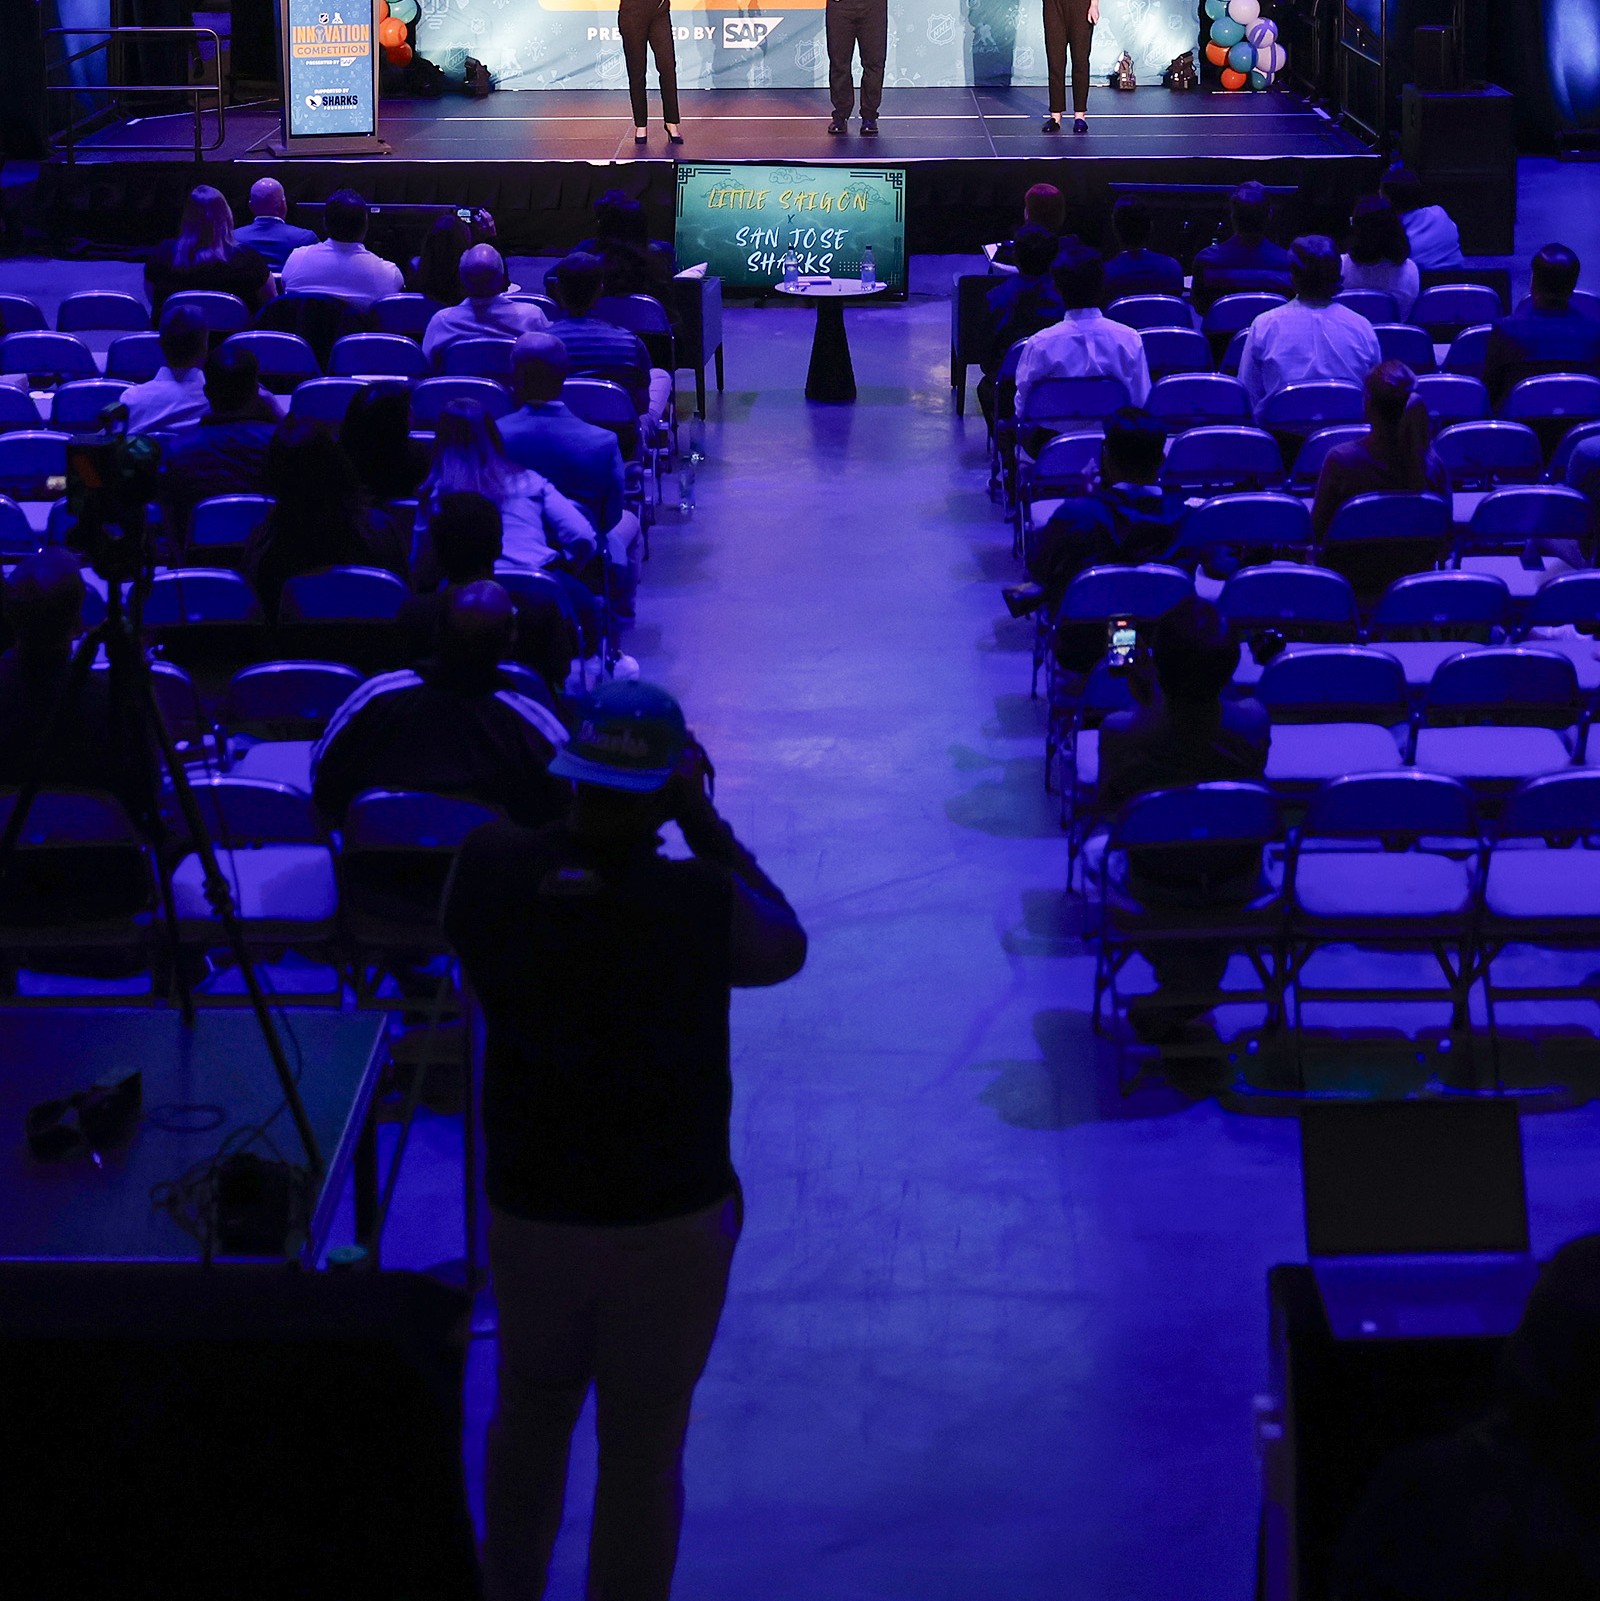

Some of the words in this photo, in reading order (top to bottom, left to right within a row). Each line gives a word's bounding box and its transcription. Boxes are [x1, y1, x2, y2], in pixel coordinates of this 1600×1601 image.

[694, 26, 717, 41] BY
[725, 23, 769, 43] SAP
[297, 45, 366, 55] COMPETITION
[322, 95, 358, 107] SHARKS
[707, 187, 771, 210] LITTLE
[778, 189, 868, 214] SAIGON
[735, 226, 780, 250] SAN
[788, 227, 849, 251] JOSE
